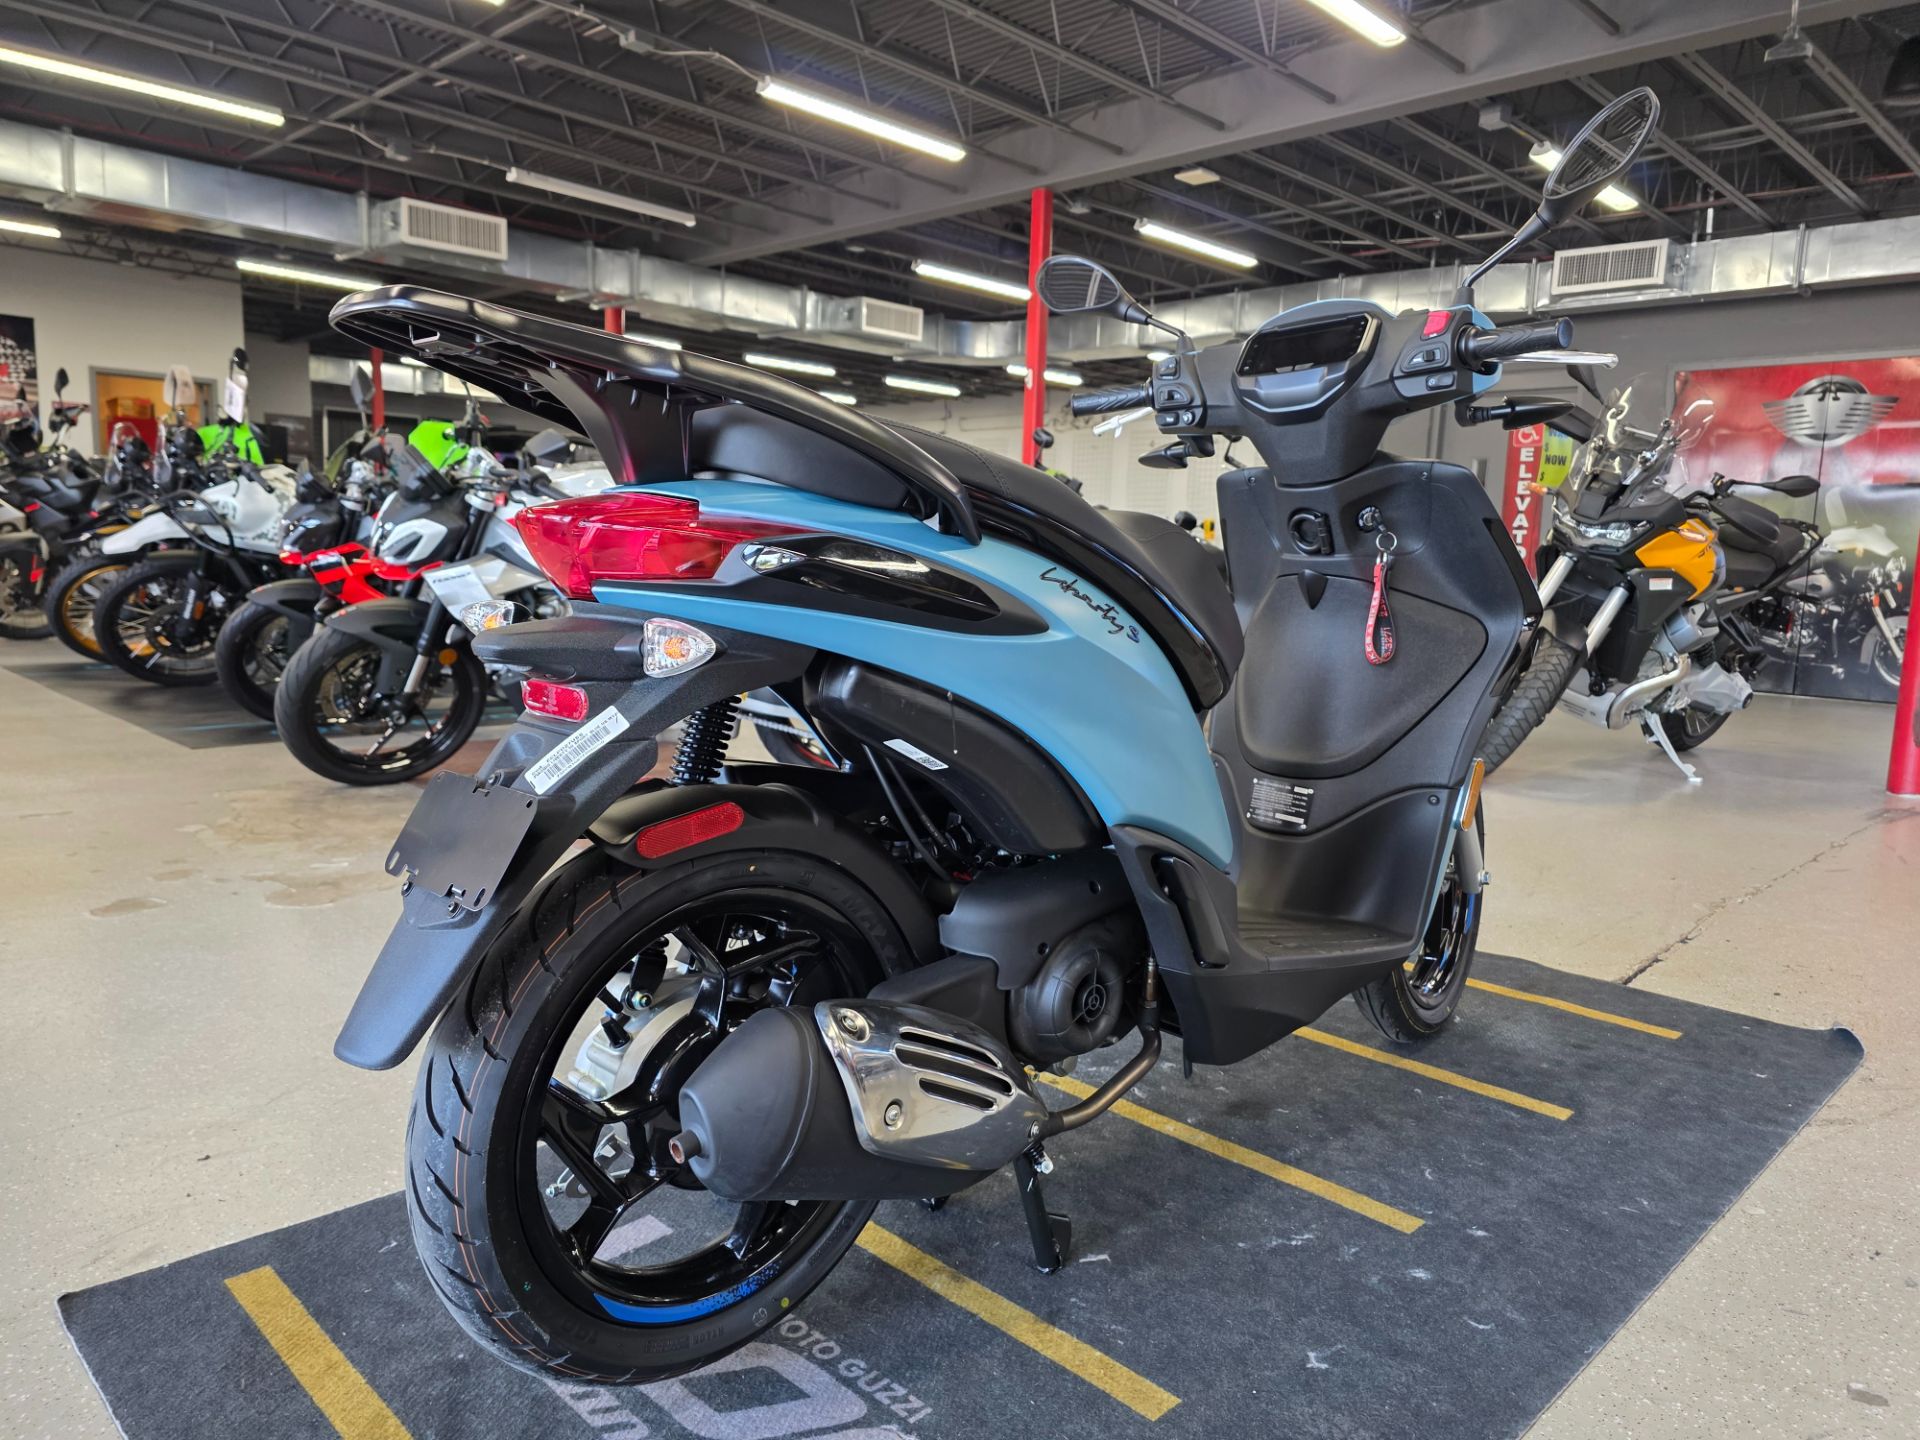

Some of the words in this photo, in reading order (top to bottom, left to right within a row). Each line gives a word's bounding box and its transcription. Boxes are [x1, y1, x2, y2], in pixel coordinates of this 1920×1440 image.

[1544, 454, 1567, 466] NOW
[1512, 447, 1534, 559] ELEVATO
[837, 1358, 933, 1424] GUZZI
